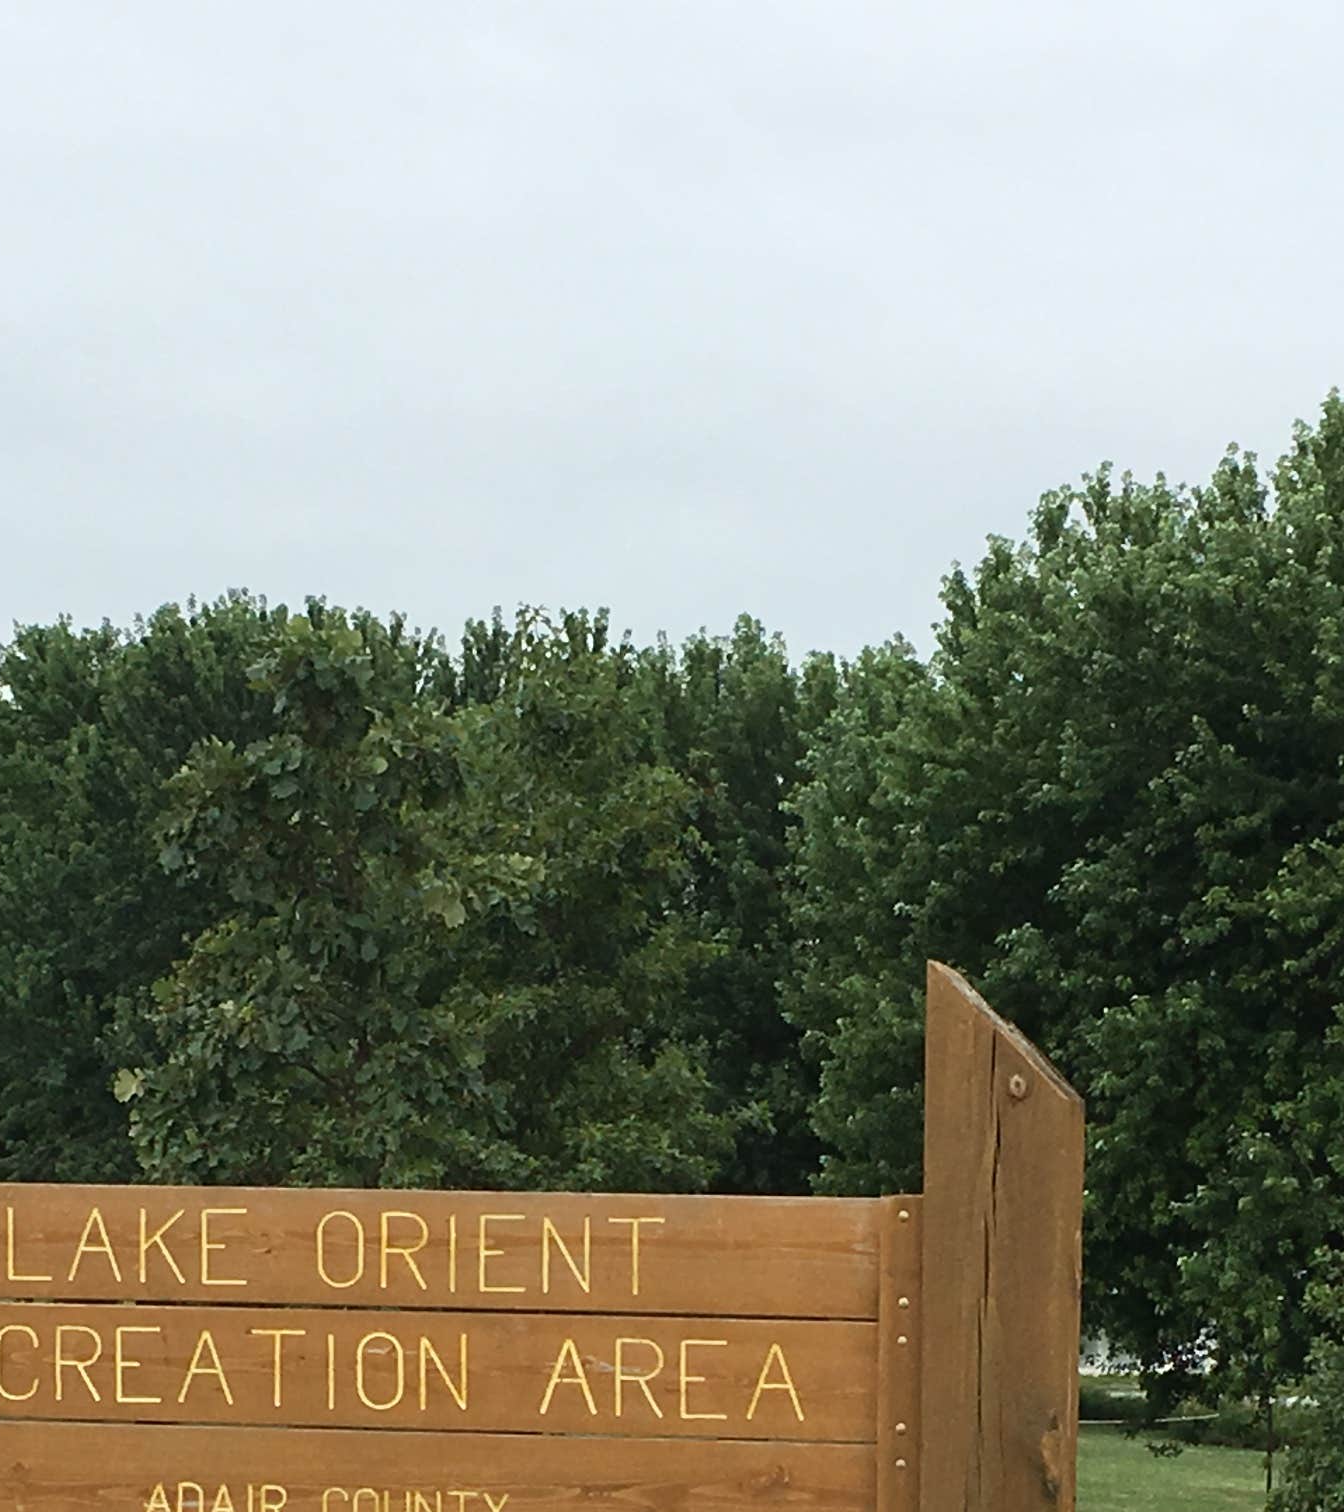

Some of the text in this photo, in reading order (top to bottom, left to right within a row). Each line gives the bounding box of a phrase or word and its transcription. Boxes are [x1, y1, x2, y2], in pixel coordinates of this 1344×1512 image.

[5, 1206, 667, 1295] LAKE ORIENT
[539, 1337, 806, 1422] AREA
